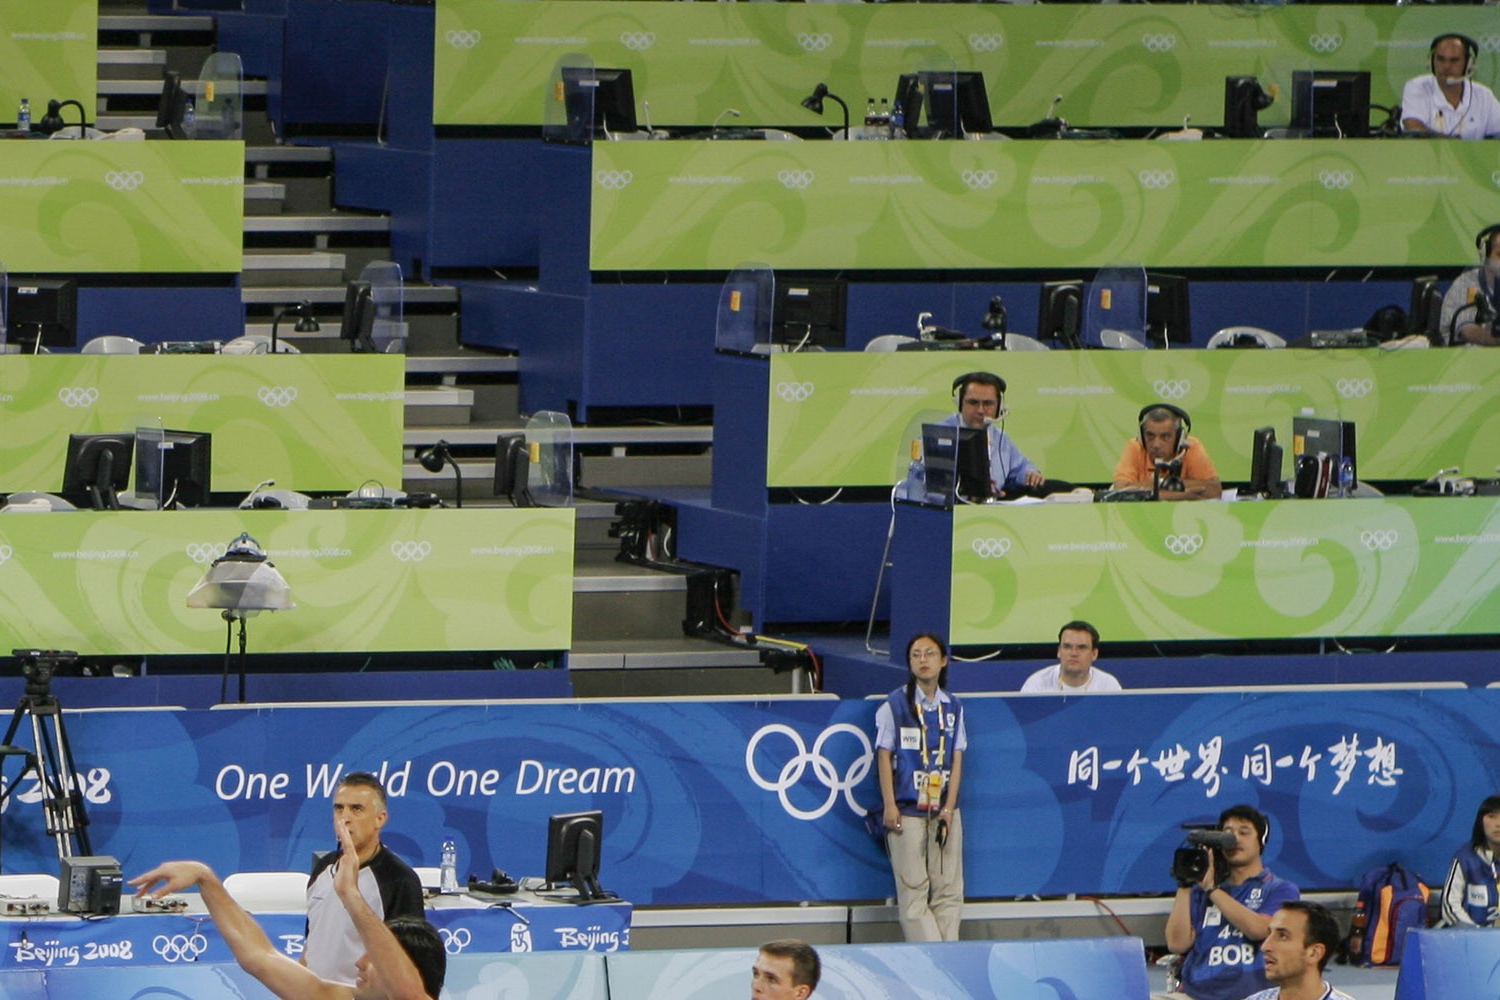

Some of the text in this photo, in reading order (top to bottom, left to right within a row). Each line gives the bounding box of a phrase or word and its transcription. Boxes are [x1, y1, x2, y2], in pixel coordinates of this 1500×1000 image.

[52, 547, 139, 561] www.beijing2008.cn
[470, 543, 555, 557] www.beijing2008.cn
[1066, 732, 1404, 798] 同一个世界 同一个梦想
[215, 758, 636, 800] One Wld One Dream
[553, 926, 619, 953] Beijing
[8, 940, 134, 967] Beijing 2008
[1208, 943, 1255, 966] BOB
